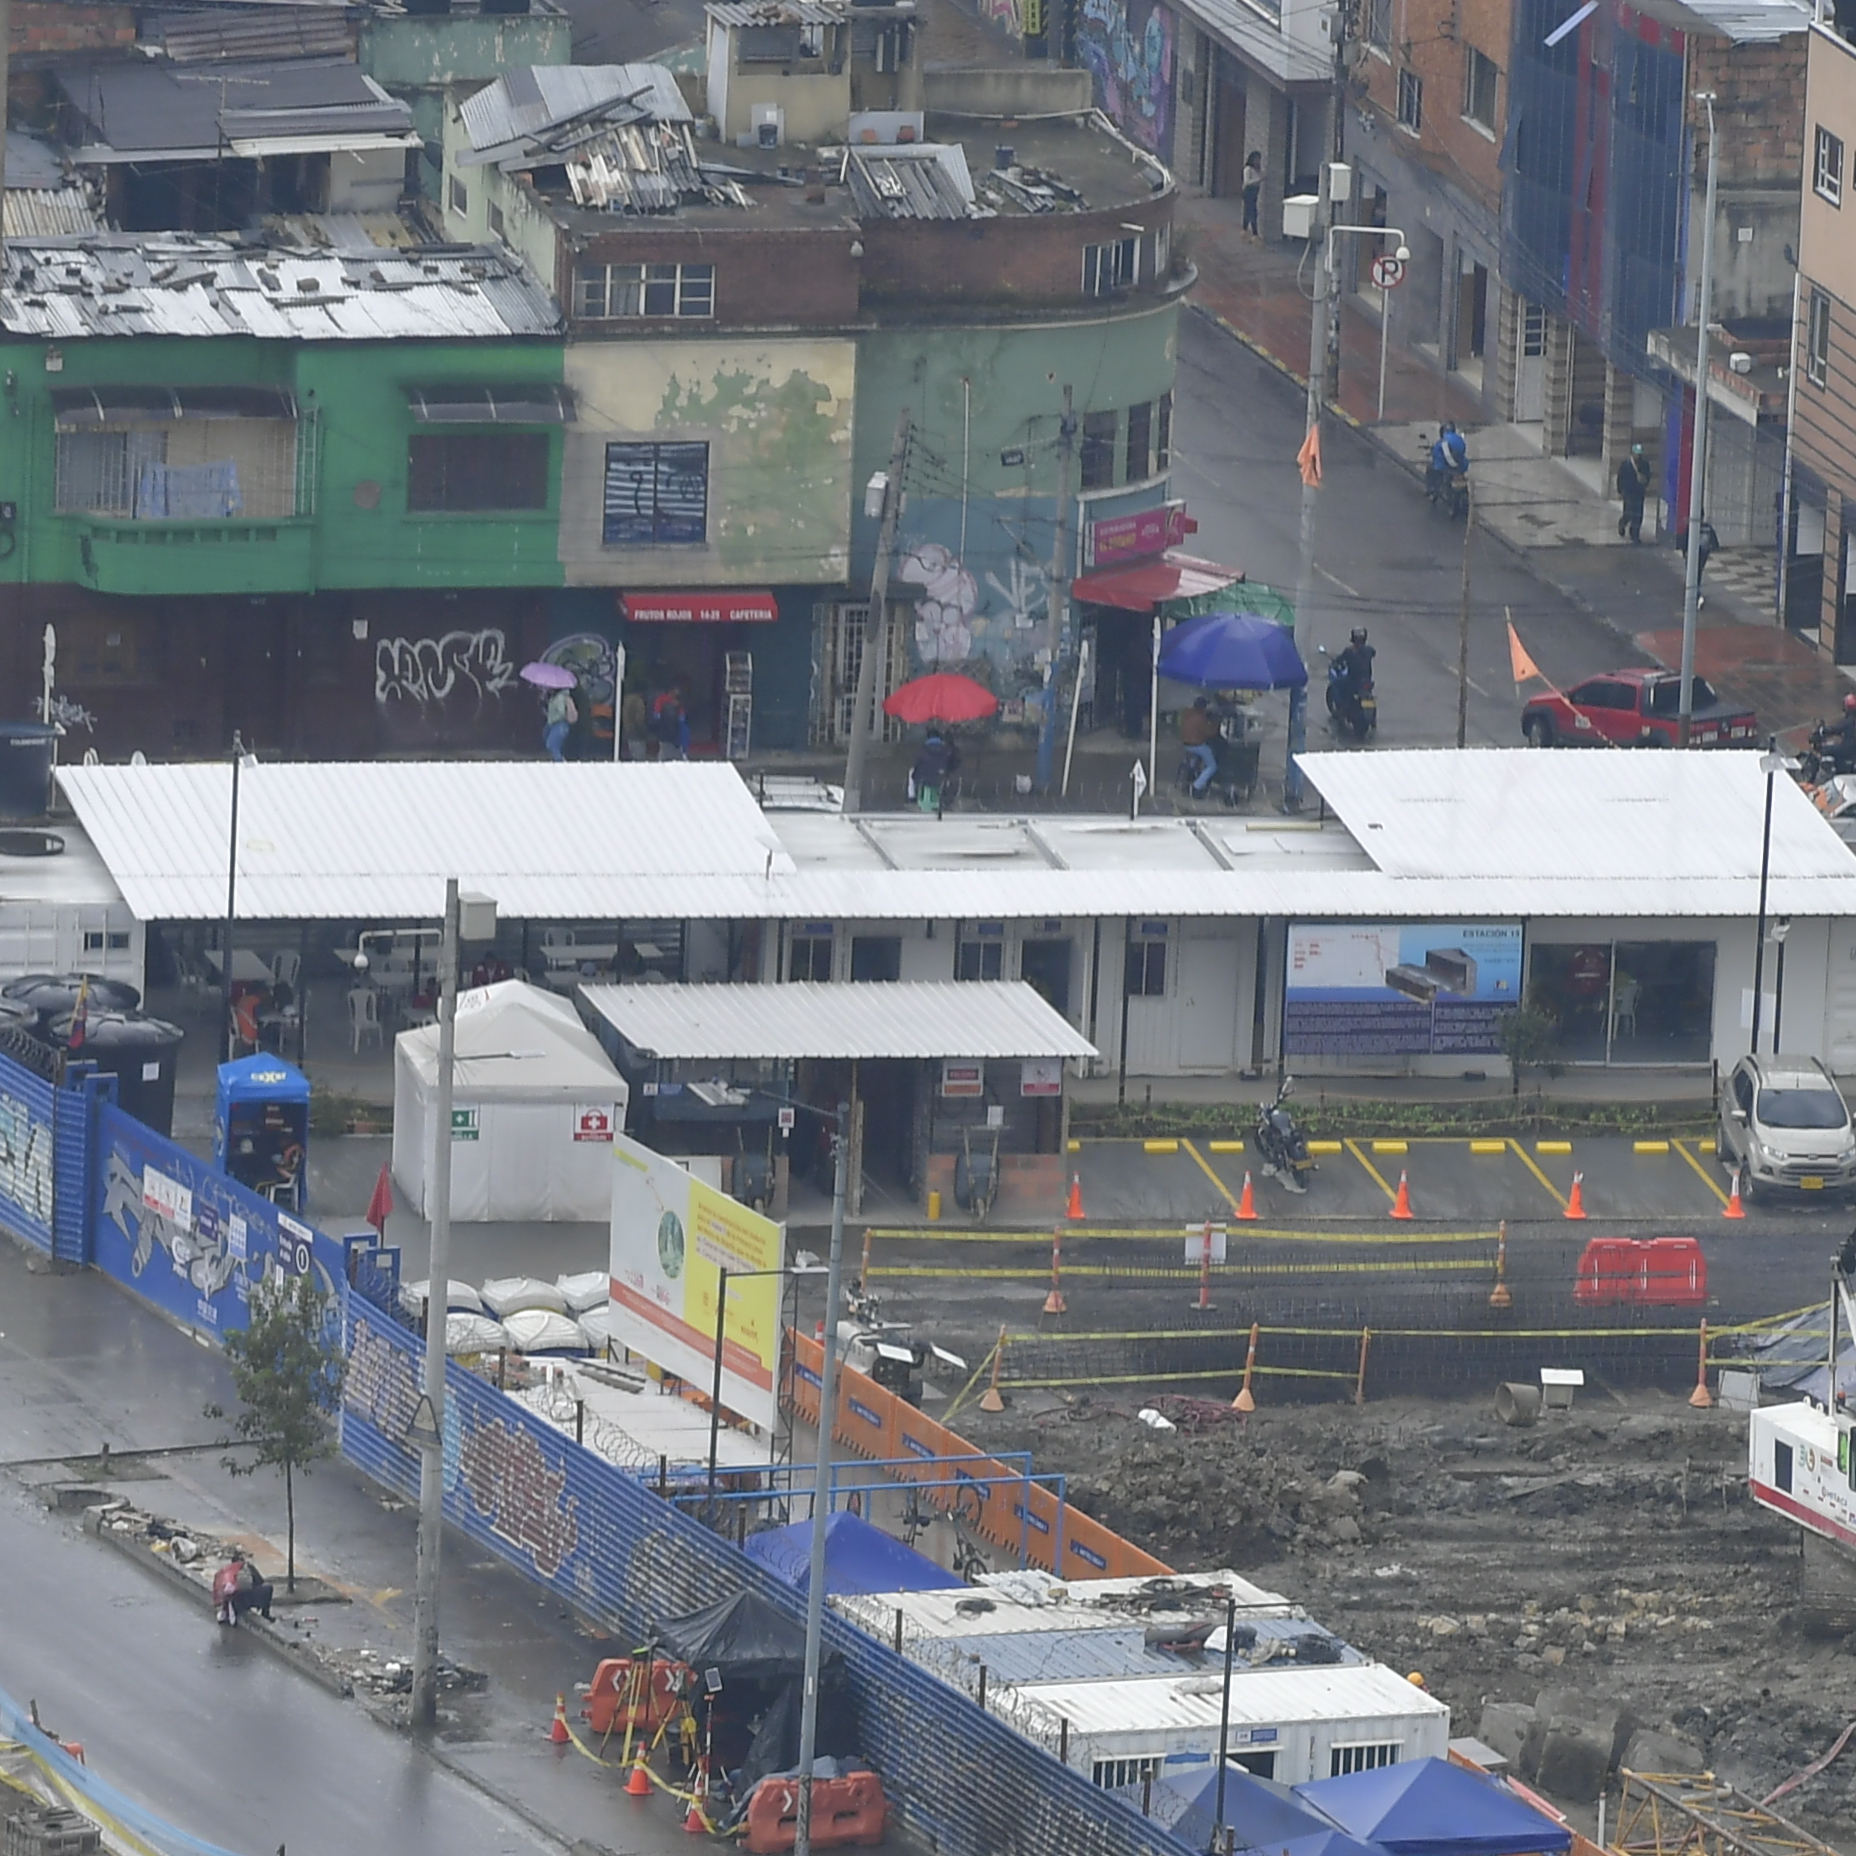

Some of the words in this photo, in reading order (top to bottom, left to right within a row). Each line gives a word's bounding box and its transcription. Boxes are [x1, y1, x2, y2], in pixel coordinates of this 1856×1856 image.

[634, 609, 665, 620] FRUTOS
[666, 609, 692, 620] ROJOS
[729, 609, 773, 620] CAFETERIA
[1462, 927, 1508, 939] ESTACIÓN
